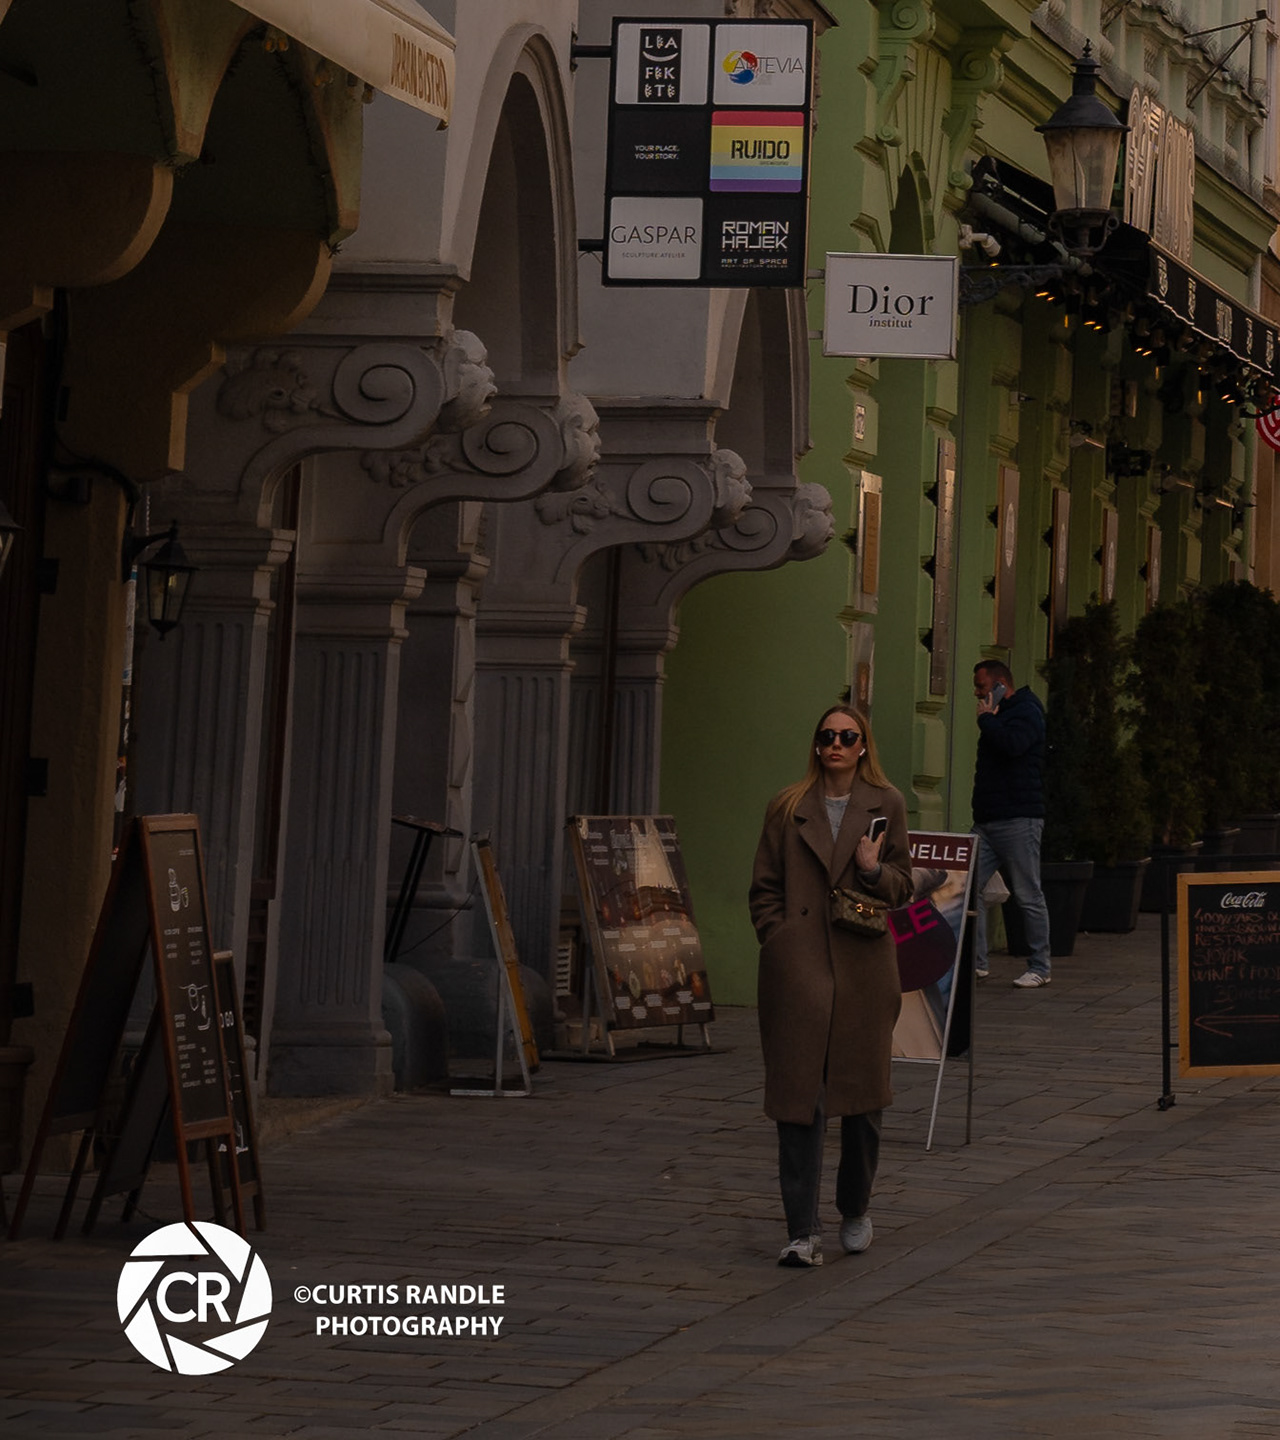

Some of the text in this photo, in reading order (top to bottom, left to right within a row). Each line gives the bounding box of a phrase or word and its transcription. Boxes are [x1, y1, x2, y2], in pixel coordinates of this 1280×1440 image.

[611, 225, 697, 244] GASPAR
[722, 221, 789, 234] ROMAN
[722, 236, 788, 248] HAJEK
[847, 284, 934, 316] Dior
[869, 316, 913, 328] institut
[908, 843, 969, 862] NELLE
